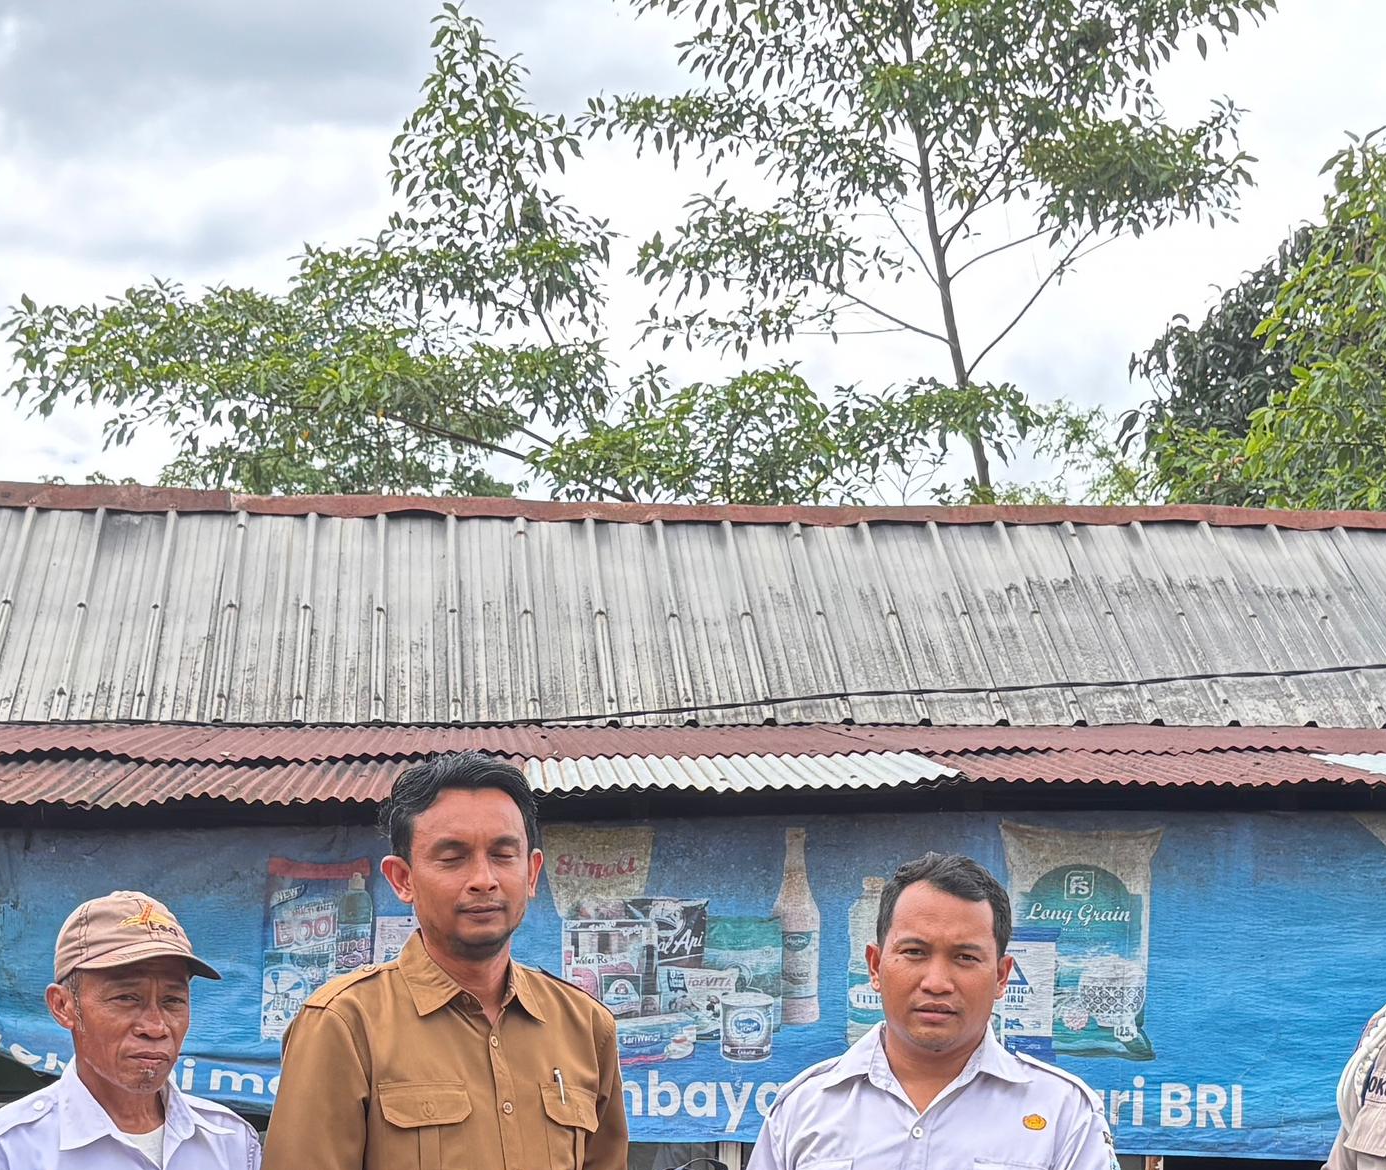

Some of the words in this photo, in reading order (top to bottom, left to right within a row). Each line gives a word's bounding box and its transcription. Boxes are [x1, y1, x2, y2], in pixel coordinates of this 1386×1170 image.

[1026, 902, 1074, 925] Long
[1077, 903, 1131, 926] Grain
[1160, 1083, 1244, 1129] BRI
